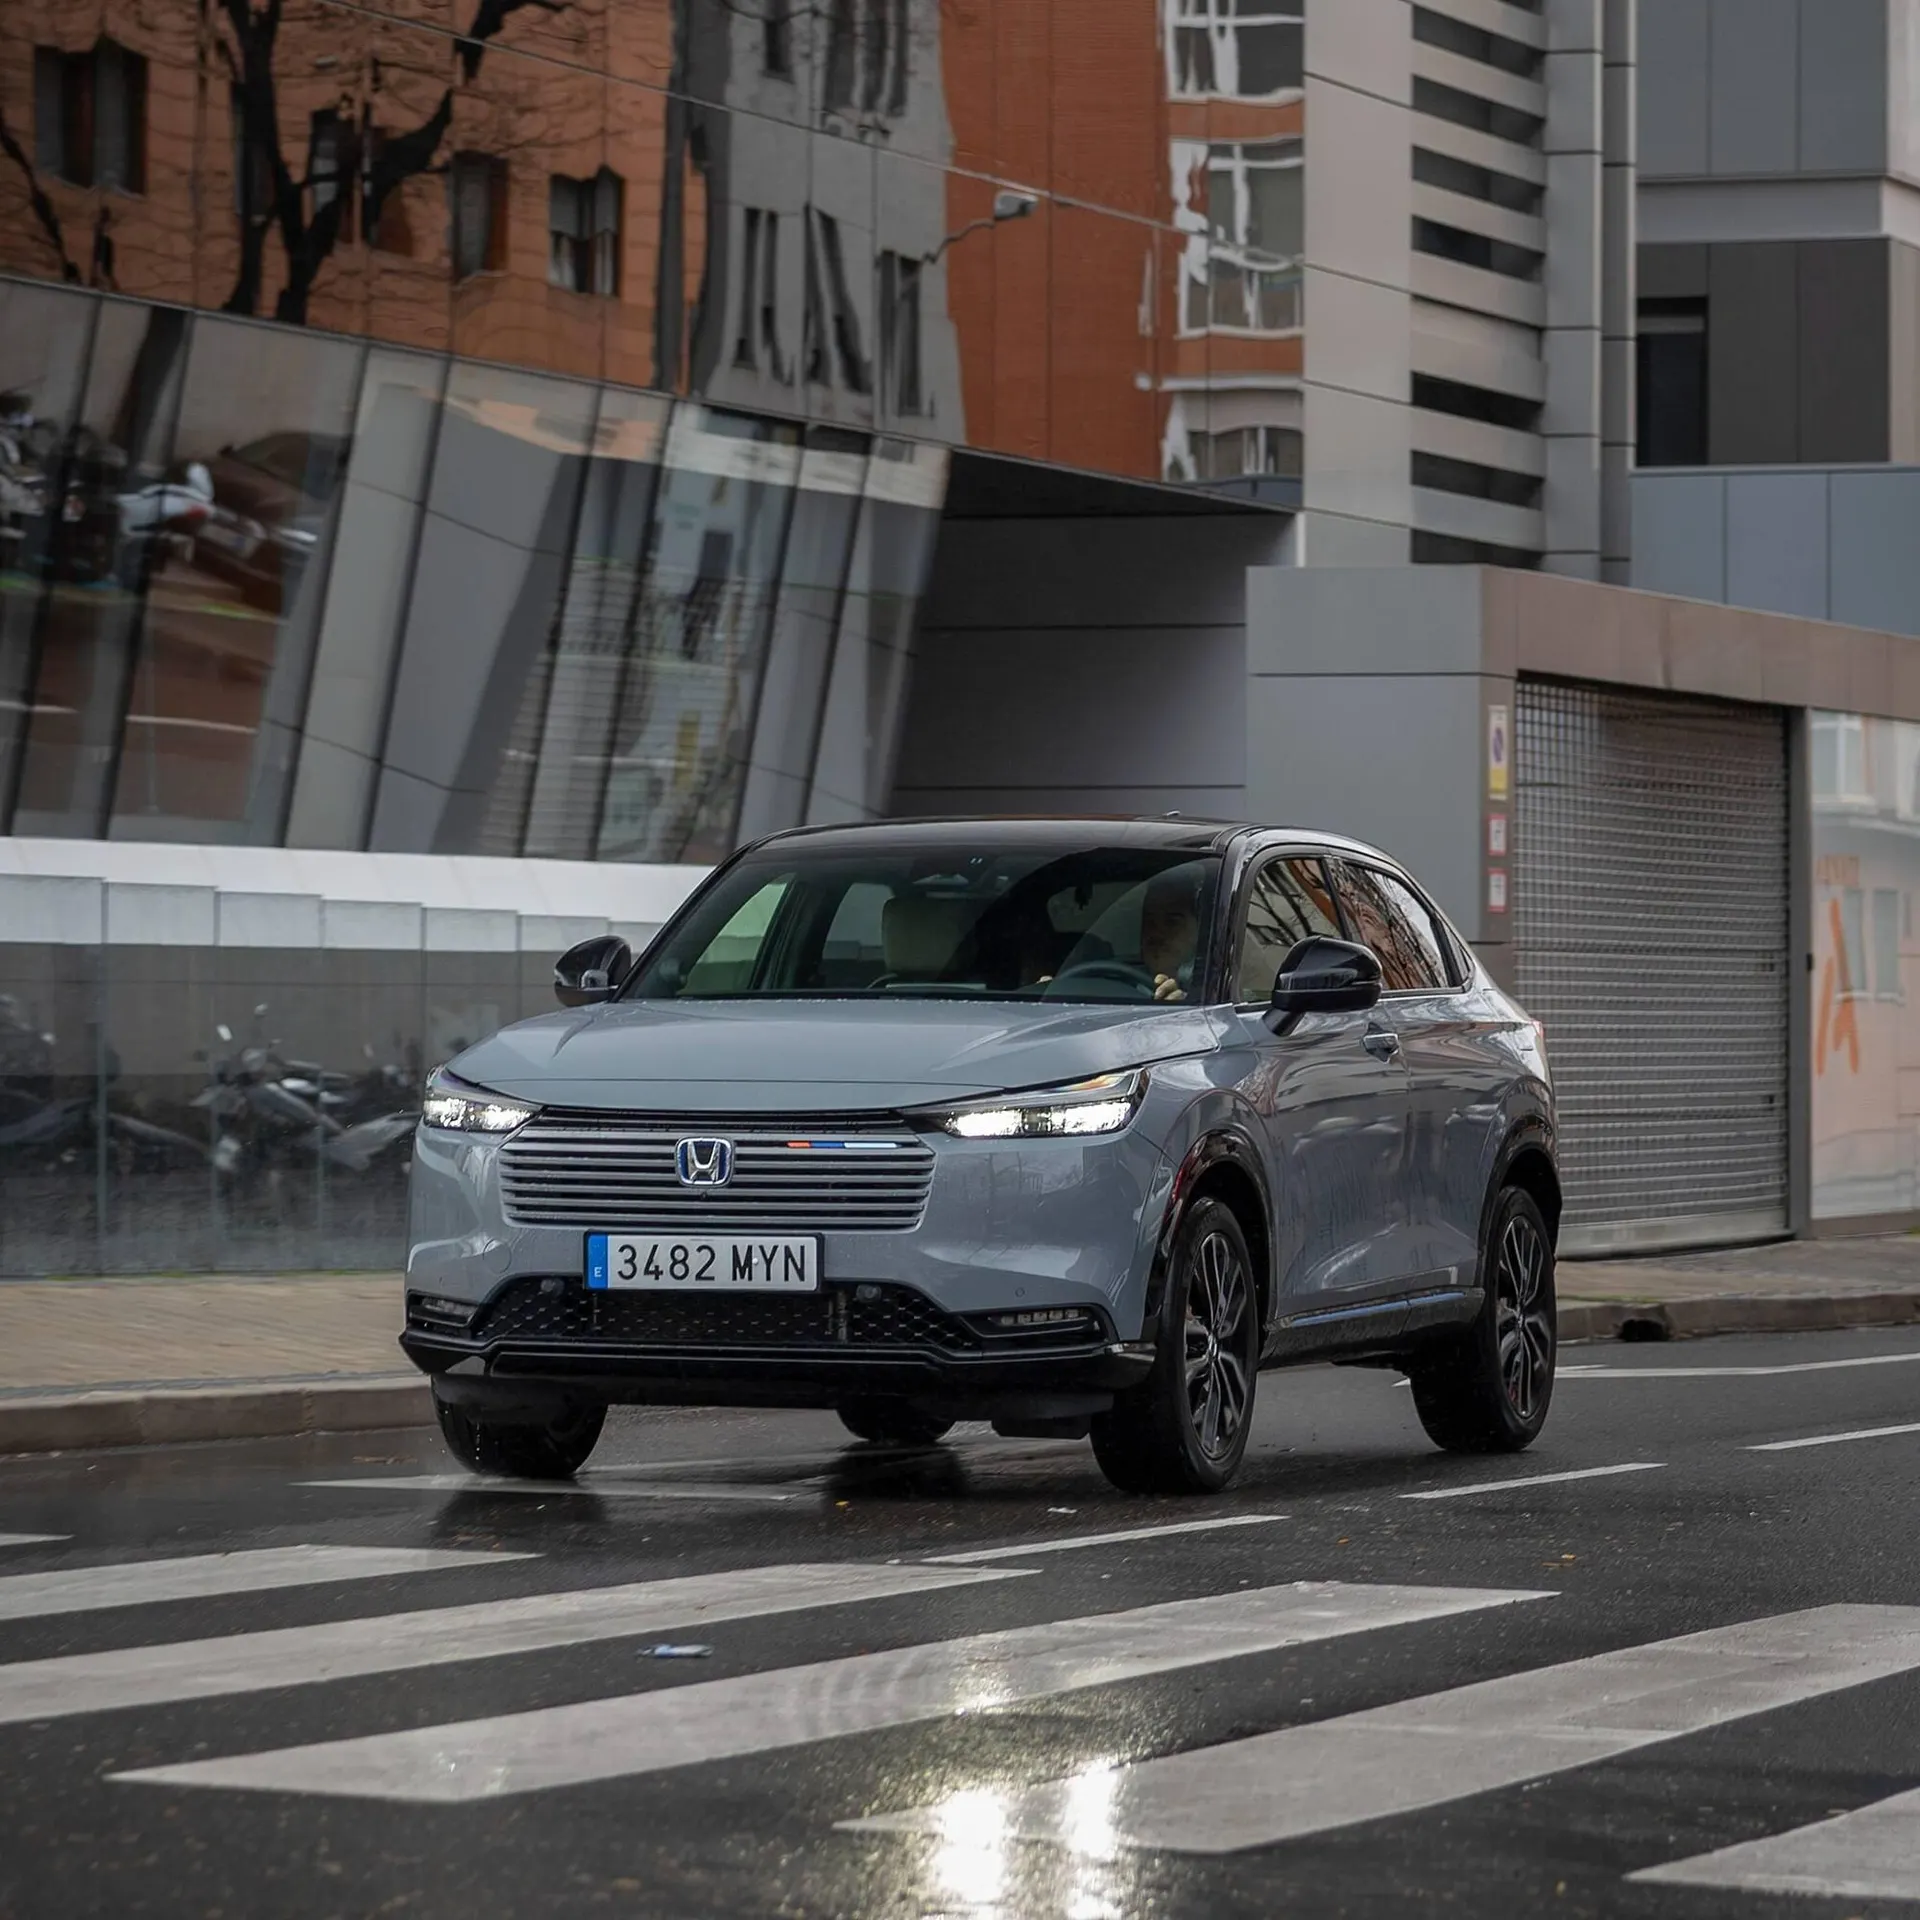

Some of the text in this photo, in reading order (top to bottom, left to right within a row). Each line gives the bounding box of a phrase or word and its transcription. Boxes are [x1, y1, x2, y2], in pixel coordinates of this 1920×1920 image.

[594, 1266, 602, 1278] E
[617, 1244, 806, 1282] 3482 MYN
